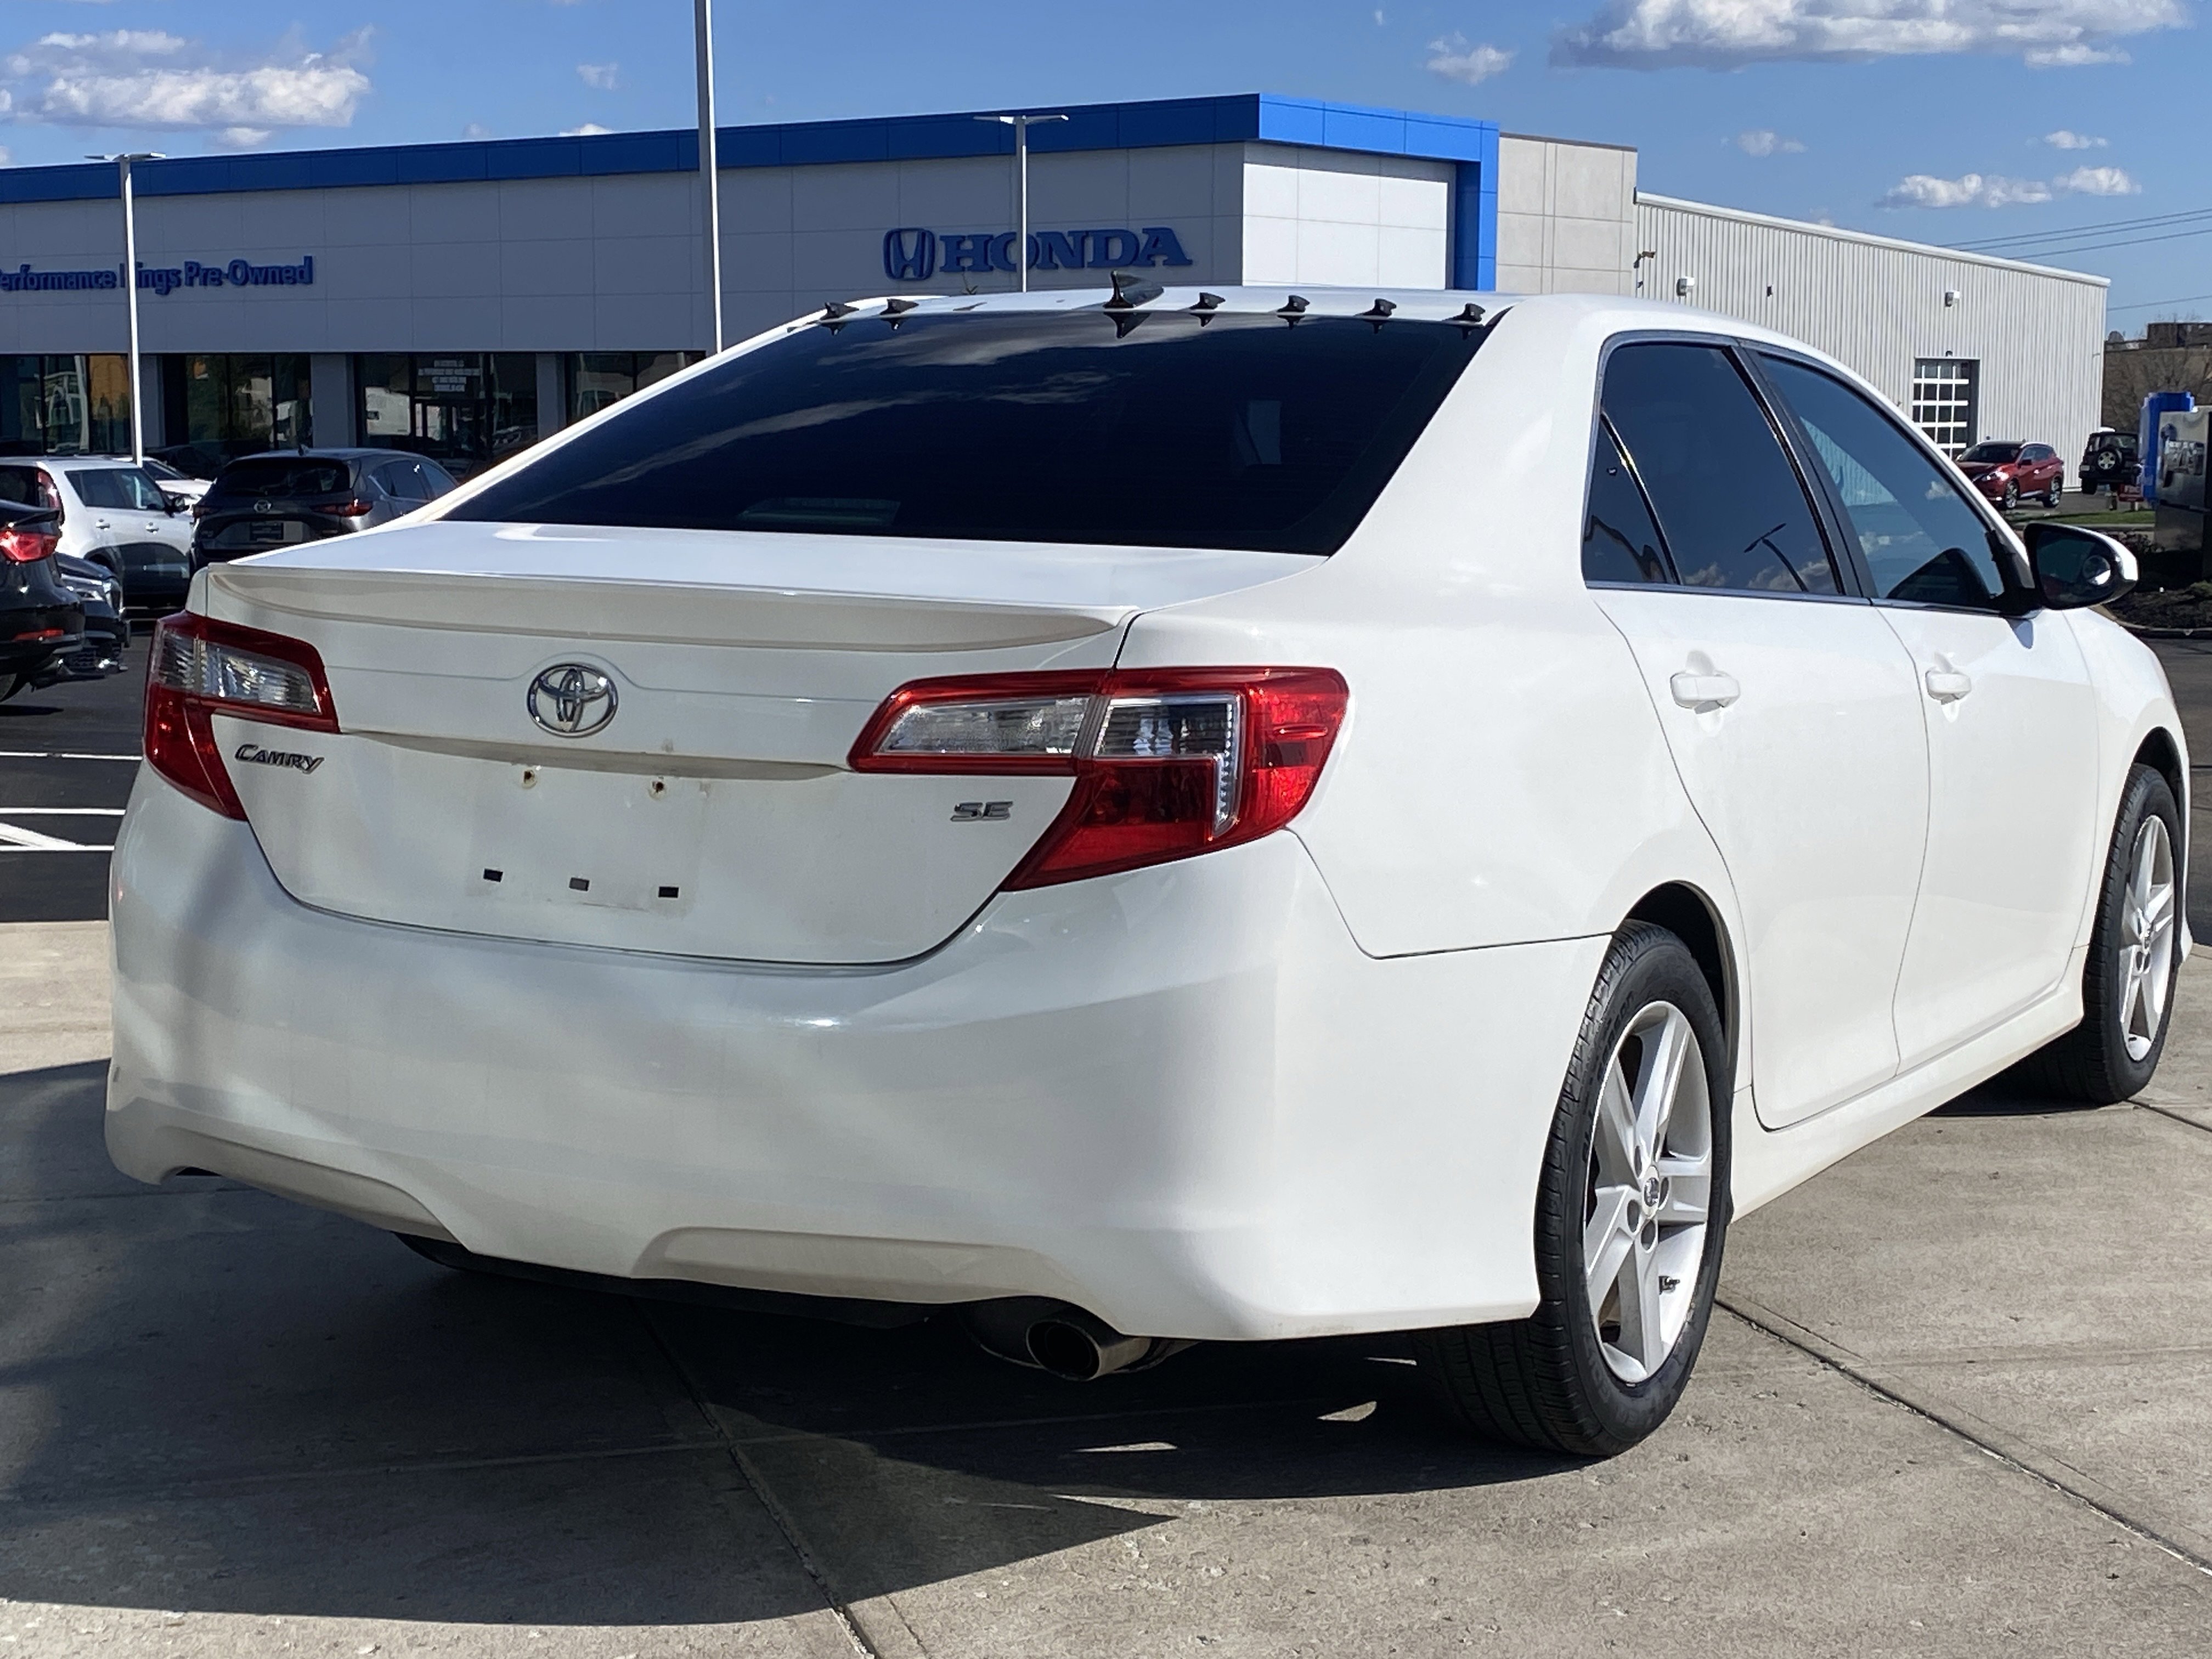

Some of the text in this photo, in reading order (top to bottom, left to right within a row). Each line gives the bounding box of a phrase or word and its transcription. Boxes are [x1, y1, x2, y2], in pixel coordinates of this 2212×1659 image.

[939, 227, 1193, 273] HONDA
[0, 263, 117, 291] erformance
[184, 255, 313, 287] Pre-Owned
[234, 743, 325, 775] CAMRY
[950, 801, 1013, 822] SE
